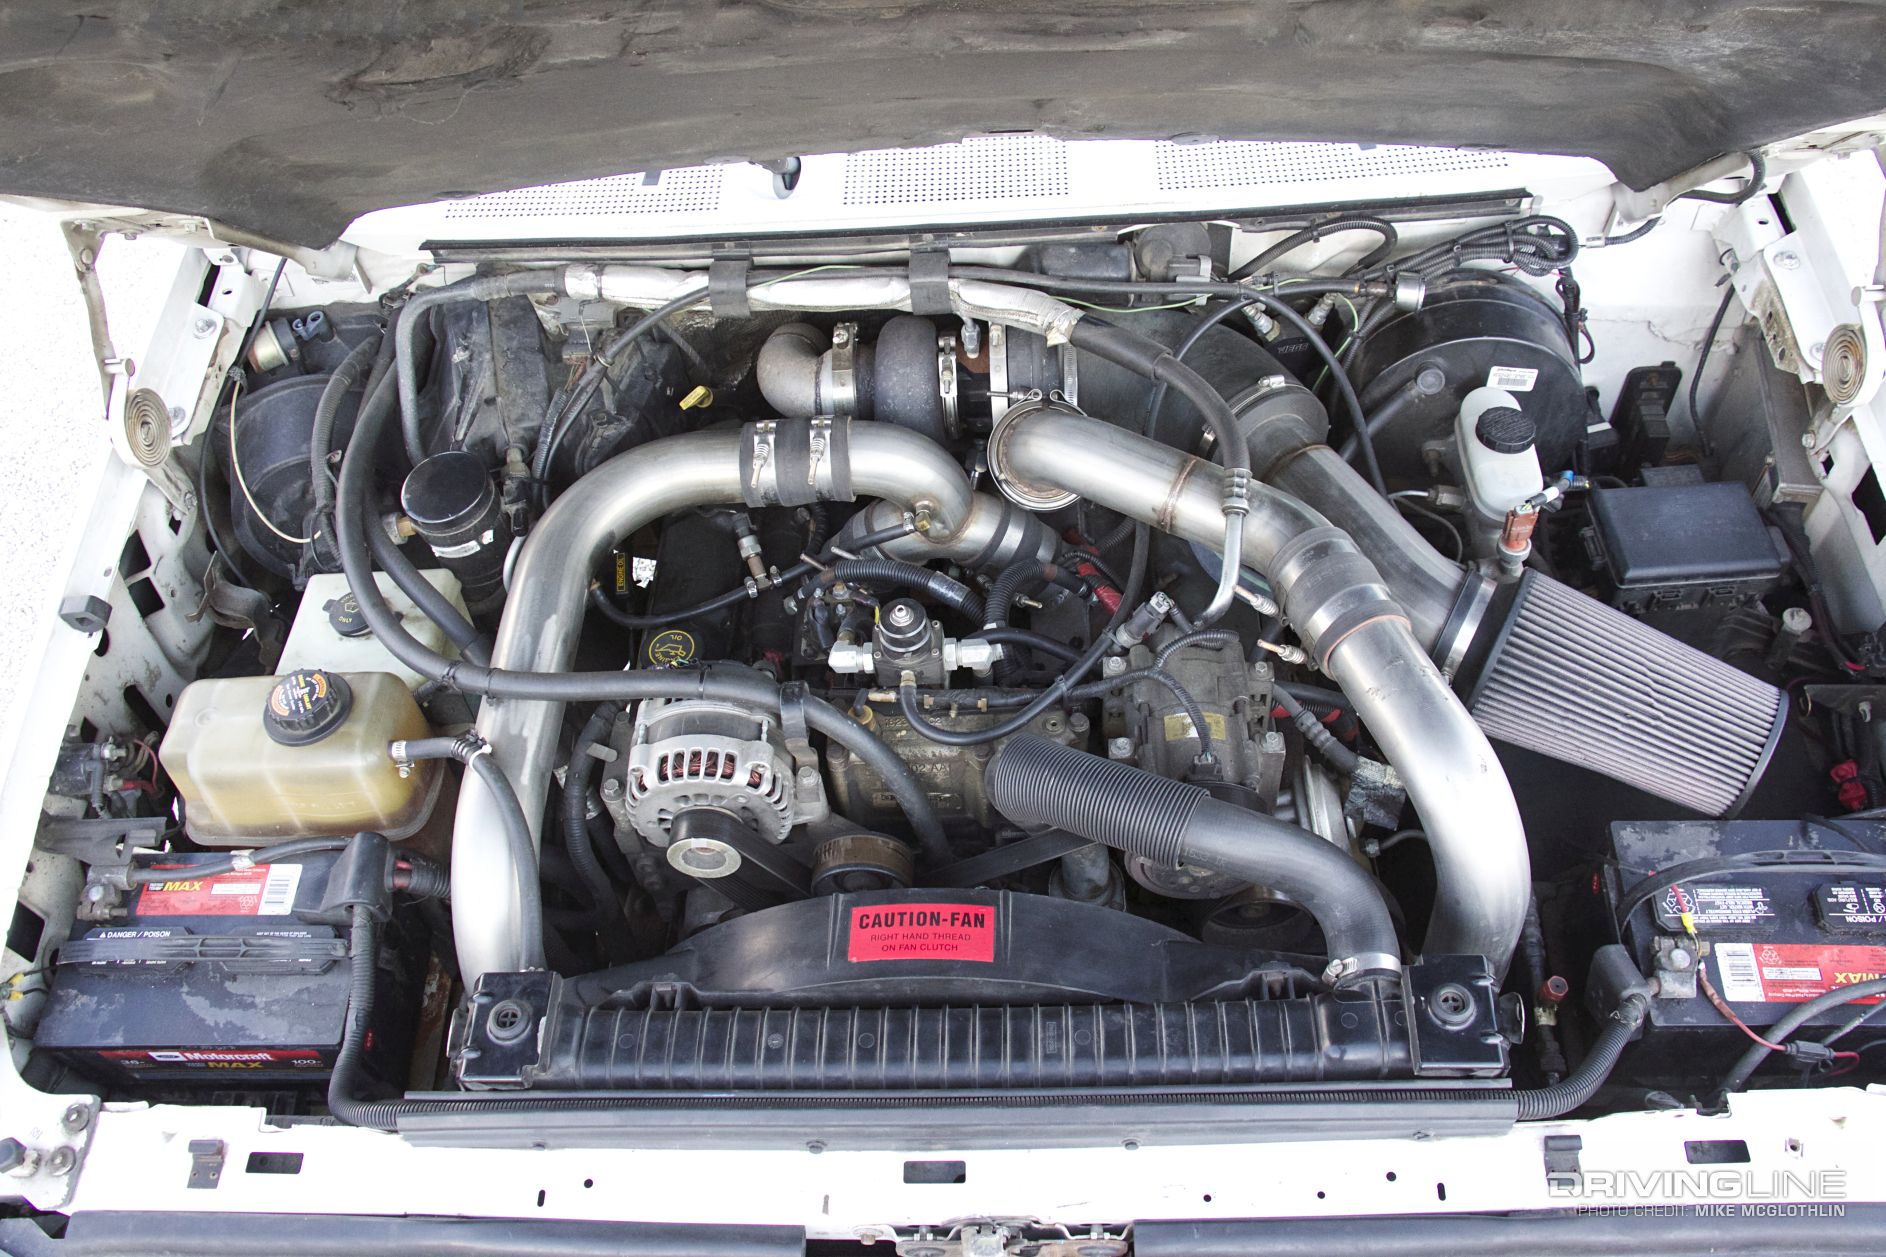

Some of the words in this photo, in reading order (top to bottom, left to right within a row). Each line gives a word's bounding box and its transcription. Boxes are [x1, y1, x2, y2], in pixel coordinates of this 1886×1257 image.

[163, 881, 204, 891] MAX
[859, 911, 986, 929] CAUTION-FAN
[143, 930, 171, 938] POISON
[870, 932, 899, 941] RIGHT
[902, 932, 929, 940] HAND
[933, 932, 971, 941] THREAD
[881, 944, 896, 952] ON
[898, 943, 917, 952] FAN
[919, 943, 958, 951] CLUTCH
[1834, 971, 1880, 983] MAX
[183, 1053, 275, 1061] Motorcraft
